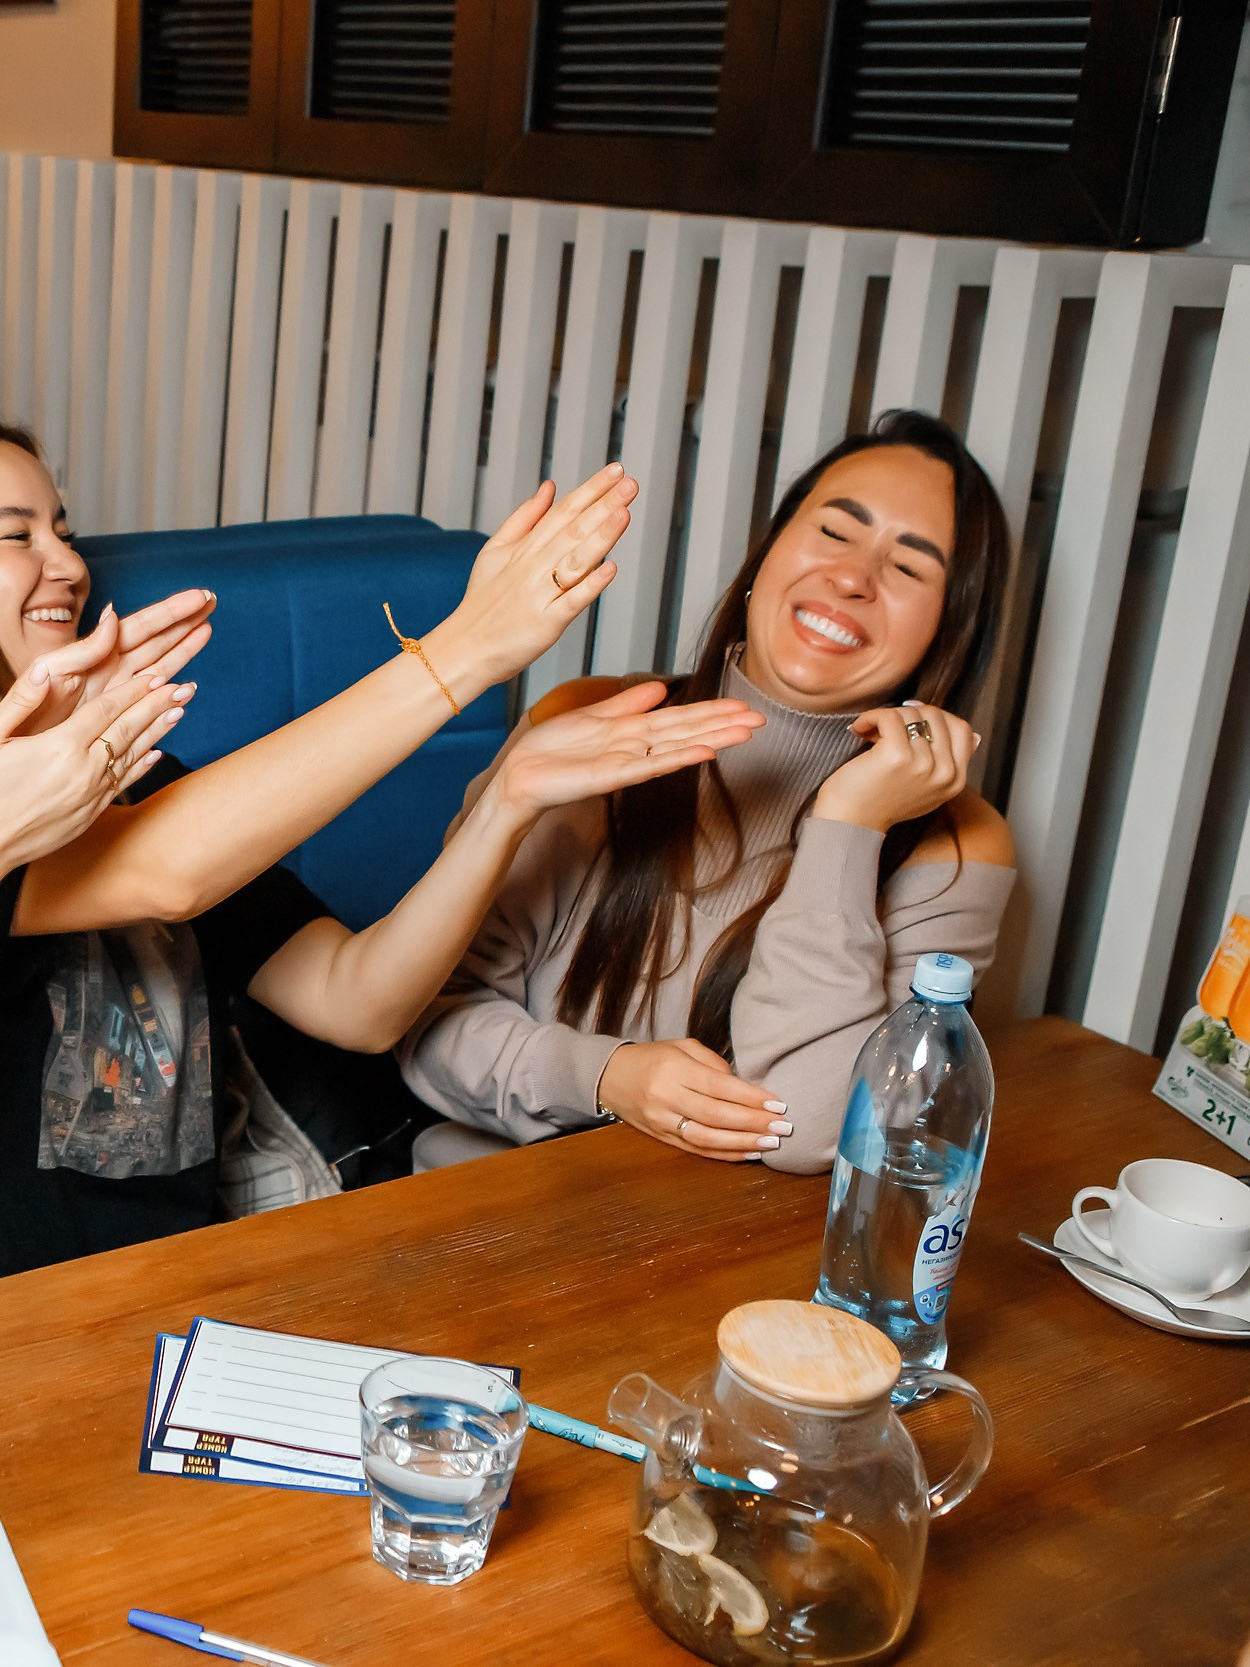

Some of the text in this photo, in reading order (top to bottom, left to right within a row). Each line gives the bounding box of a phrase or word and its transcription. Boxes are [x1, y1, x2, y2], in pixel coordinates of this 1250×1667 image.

[1202, 1099, 1236, 1135] 2+1
[923, 1219, 966, 1254] as
[196, 1442, 228, 1453] НОМЕР
[183, 1465, 215, 1475] НОМЕР
